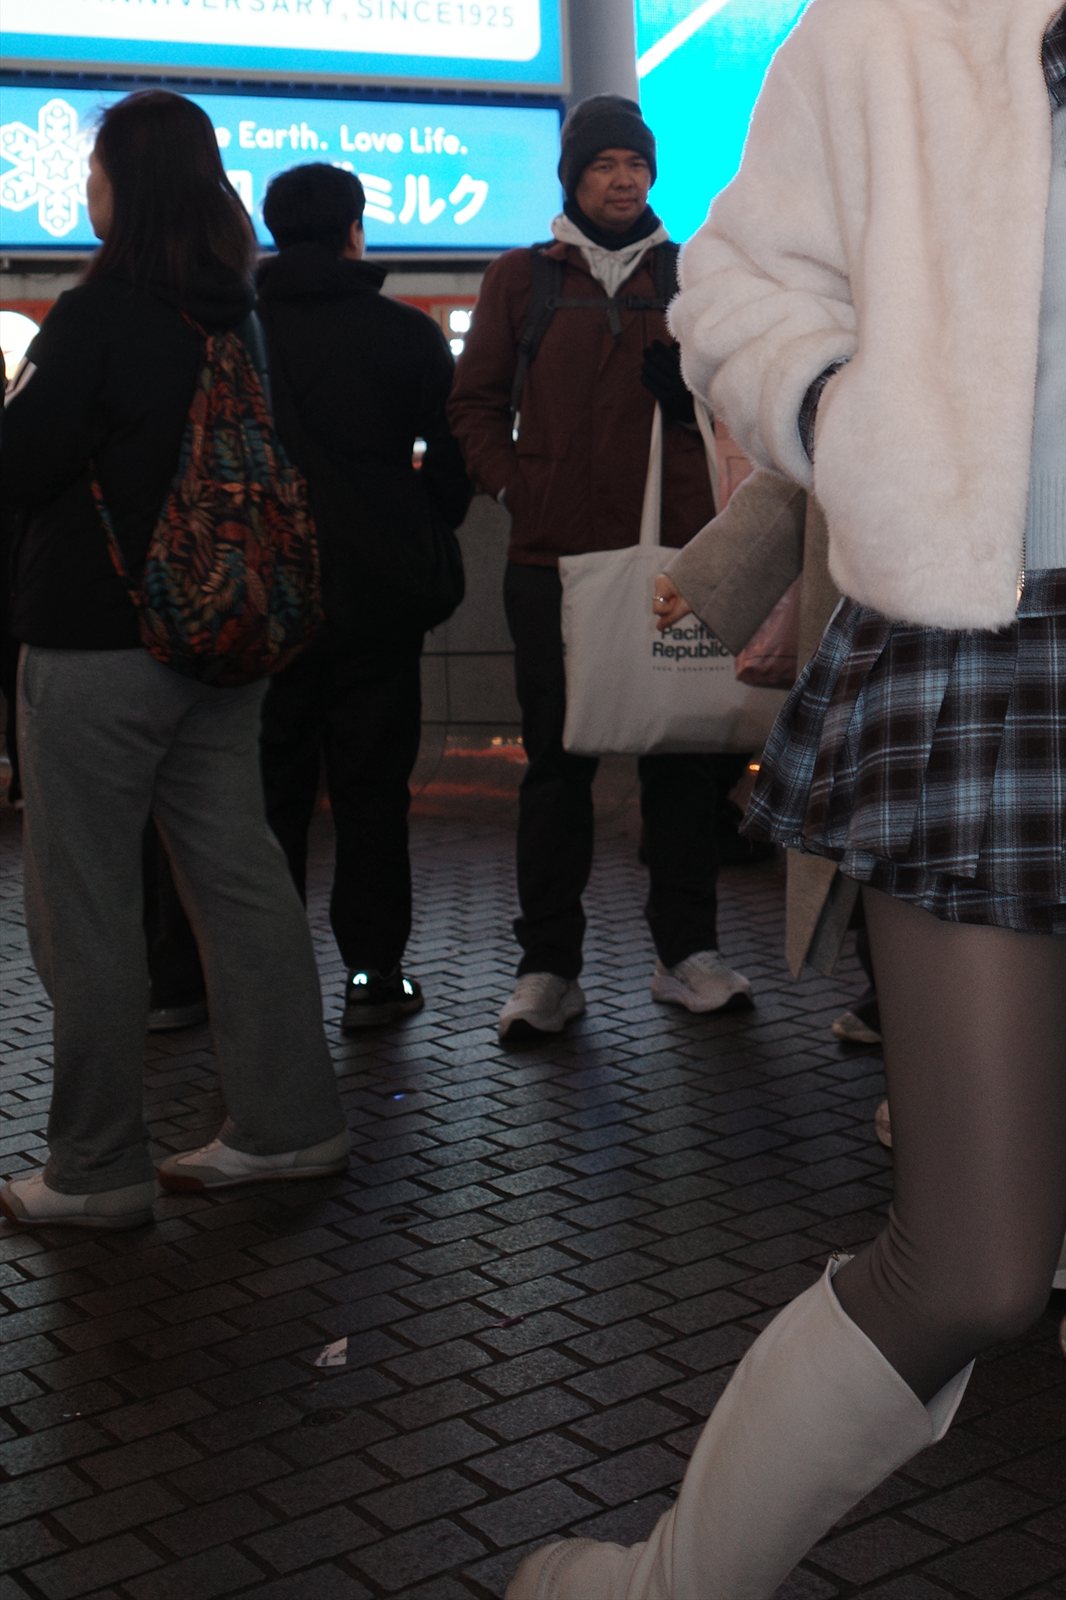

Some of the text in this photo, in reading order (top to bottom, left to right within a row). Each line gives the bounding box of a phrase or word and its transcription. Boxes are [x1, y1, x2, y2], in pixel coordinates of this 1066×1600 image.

[239, 121, 328, 151] Earth.
[340, 124, 403, 153] Love
[411, 126, 468, 155] Life.
[651, 641, 730, 662] Republic
